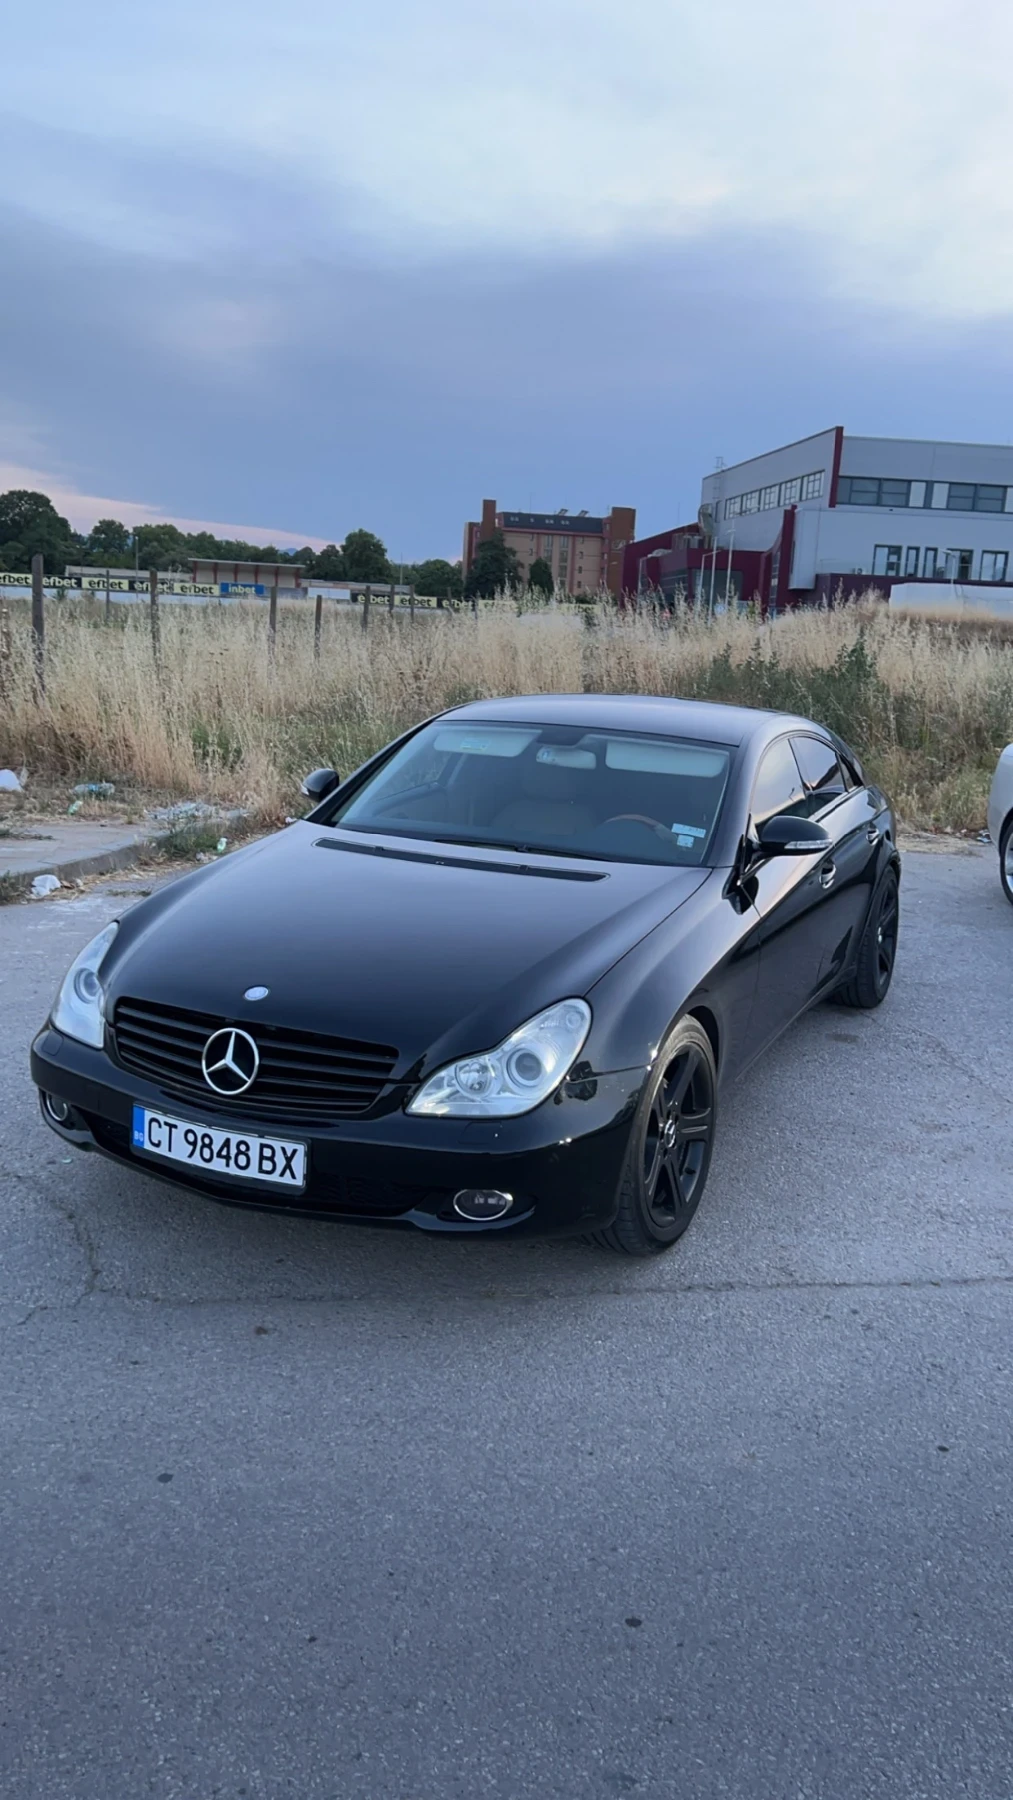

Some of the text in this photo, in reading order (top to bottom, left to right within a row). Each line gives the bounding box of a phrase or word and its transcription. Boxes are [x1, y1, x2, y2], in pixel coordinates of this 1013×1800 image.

[43, 577, 77, 587] efbet
[180, 584, 214, 594] efbet
[228, 583, 256, 593] inbet
[357, 594, 389, 604] ebet
[442, 599, 473, 609] ebet
[134, 1130, 144, 1142] BG
[148, 1117, 299, 1180] CT 9848 BX
